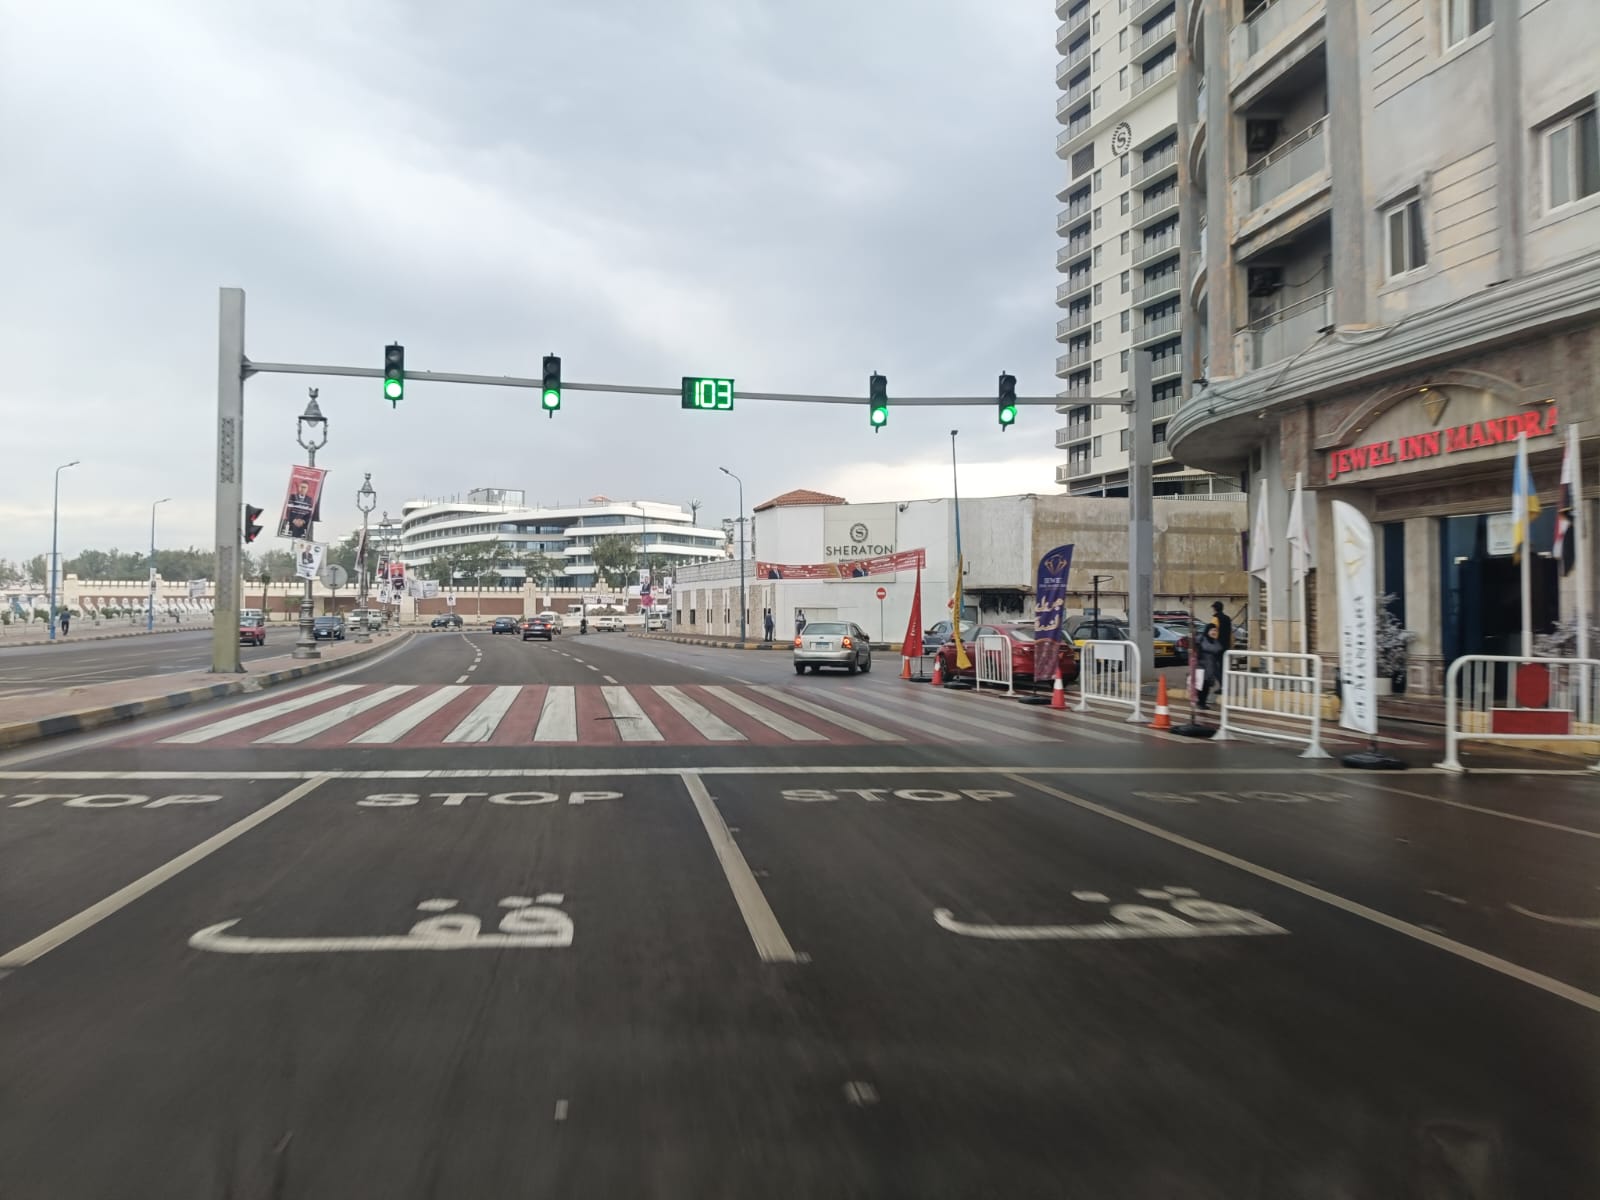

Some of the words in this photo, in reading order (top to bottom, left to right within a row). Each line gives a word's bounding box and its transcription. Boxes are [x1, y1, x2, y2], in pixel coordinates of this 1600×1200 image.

[695, 379, 732, 409] 103
[1328, 440, 1396, 480] JEWEL
[1398, 430, 1441, 462] INN
[825, 544, 894, 557] SHERATON
[0, 793, 224, 809] TOP
[356, 790, 624, 807] STOP
[780, 788, 1016, 804] STOP
[1130, 790, 1353, 804] STOP
[933, 885, 1291, 939] قف
[188, 893, 574, 953] قف
